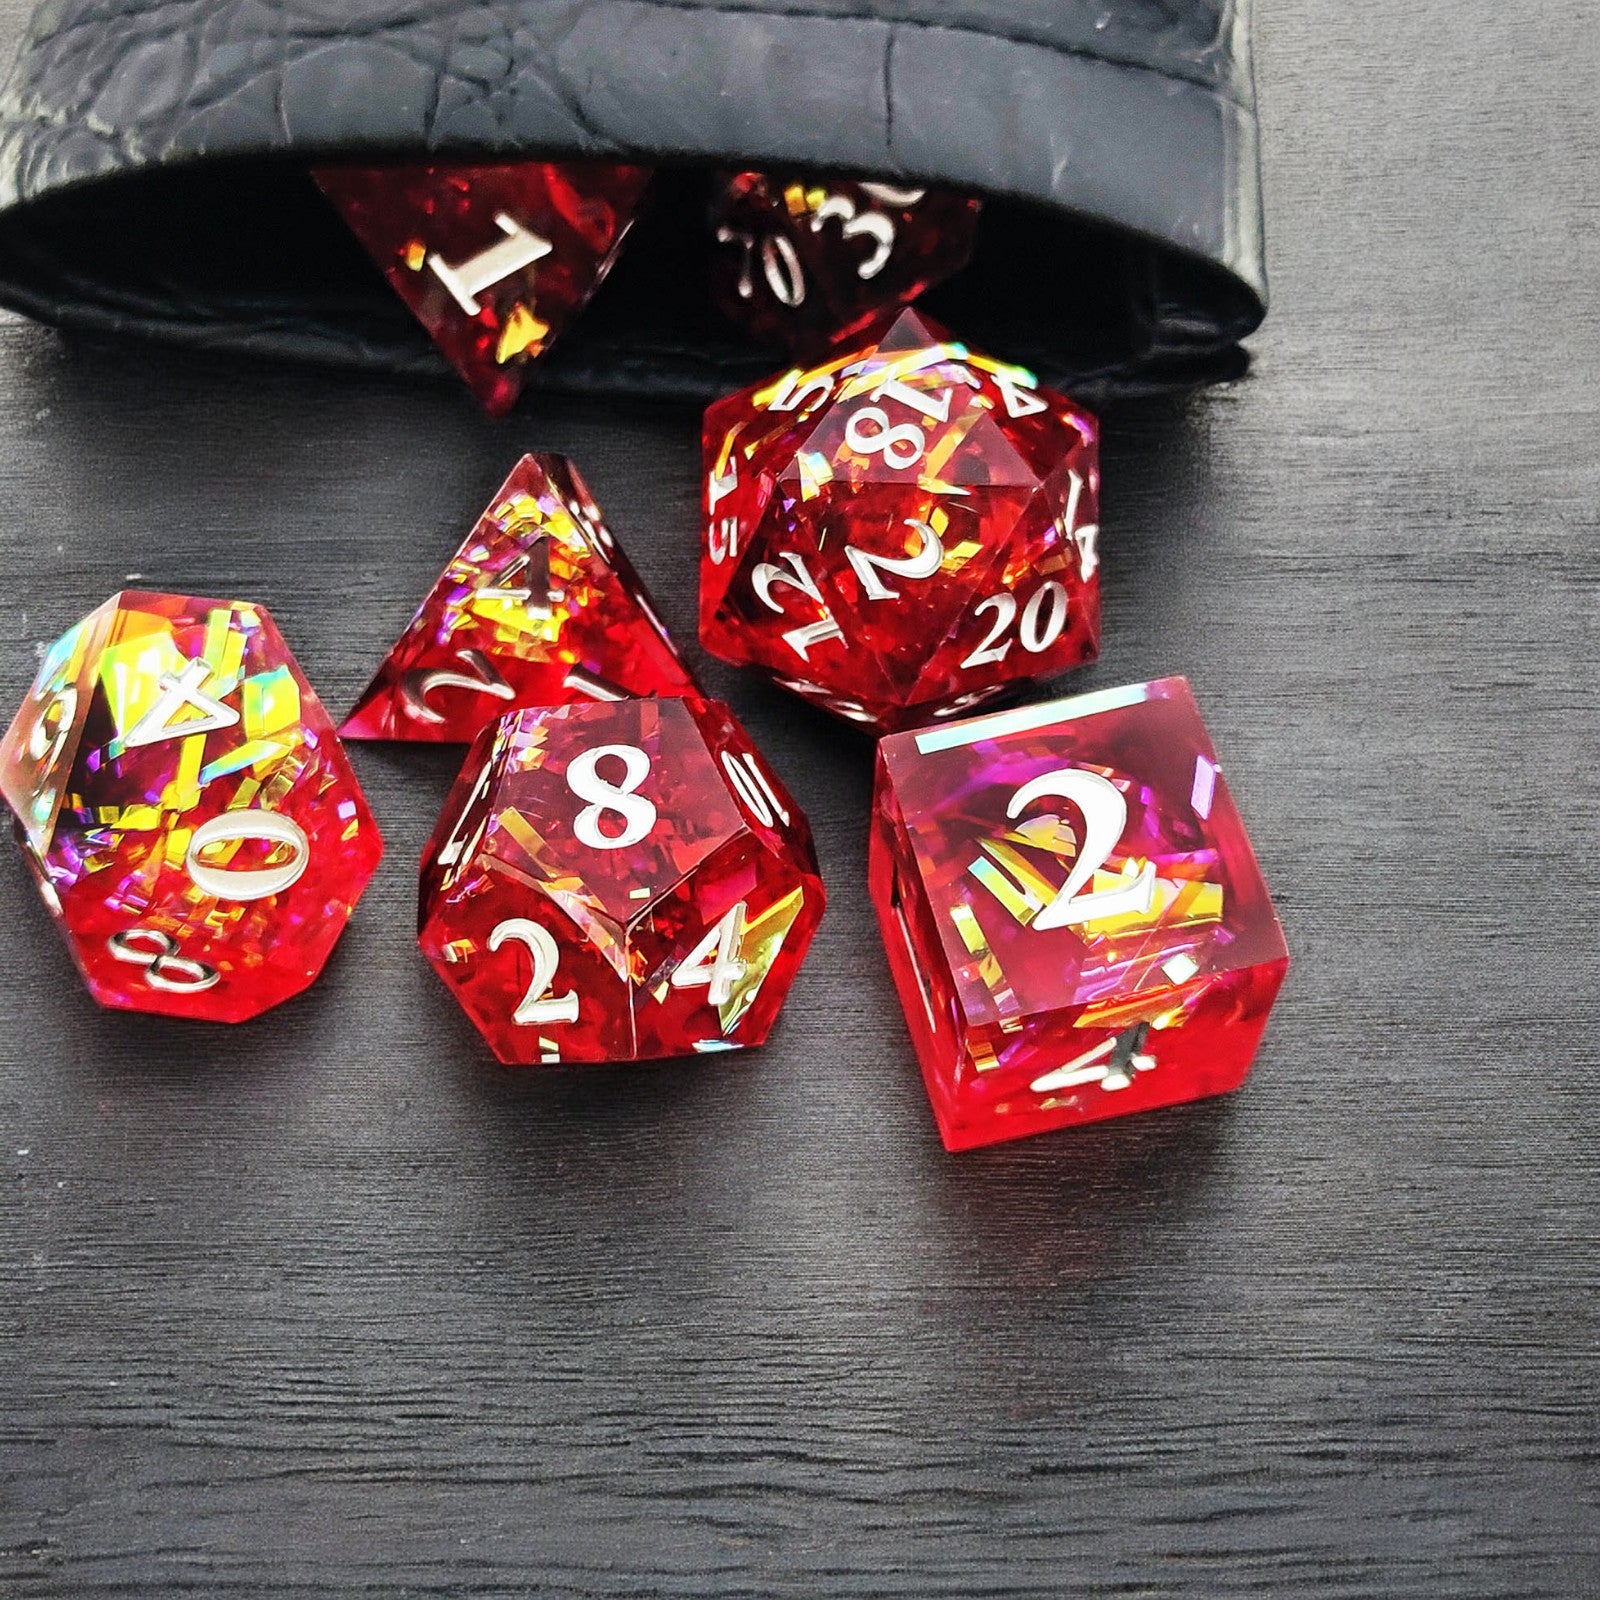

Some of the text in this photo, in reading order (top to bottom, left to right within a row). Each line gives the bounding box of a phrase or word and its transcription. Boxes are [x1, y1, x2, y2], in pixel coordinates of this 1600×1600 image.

[428, 212, 553, 317] 1
[845, 367, 953, 470] 18
[751, 551, 850, 663] 12
[845, 518, 944, 601] 2
[960, 581, 1068, 669] 20
[121, 656, 241, 748] 4
[566, 744, 657, 850] 8
[186, 809, 310, 901] 0
[1006, 768, 1157, 931] 2
[107, 929, 221, 993] 8
[486, 917, 580, 1025] 2
[671, 900, 747, 1006] 4
[1030, 1022, 1158, 1092] 4
